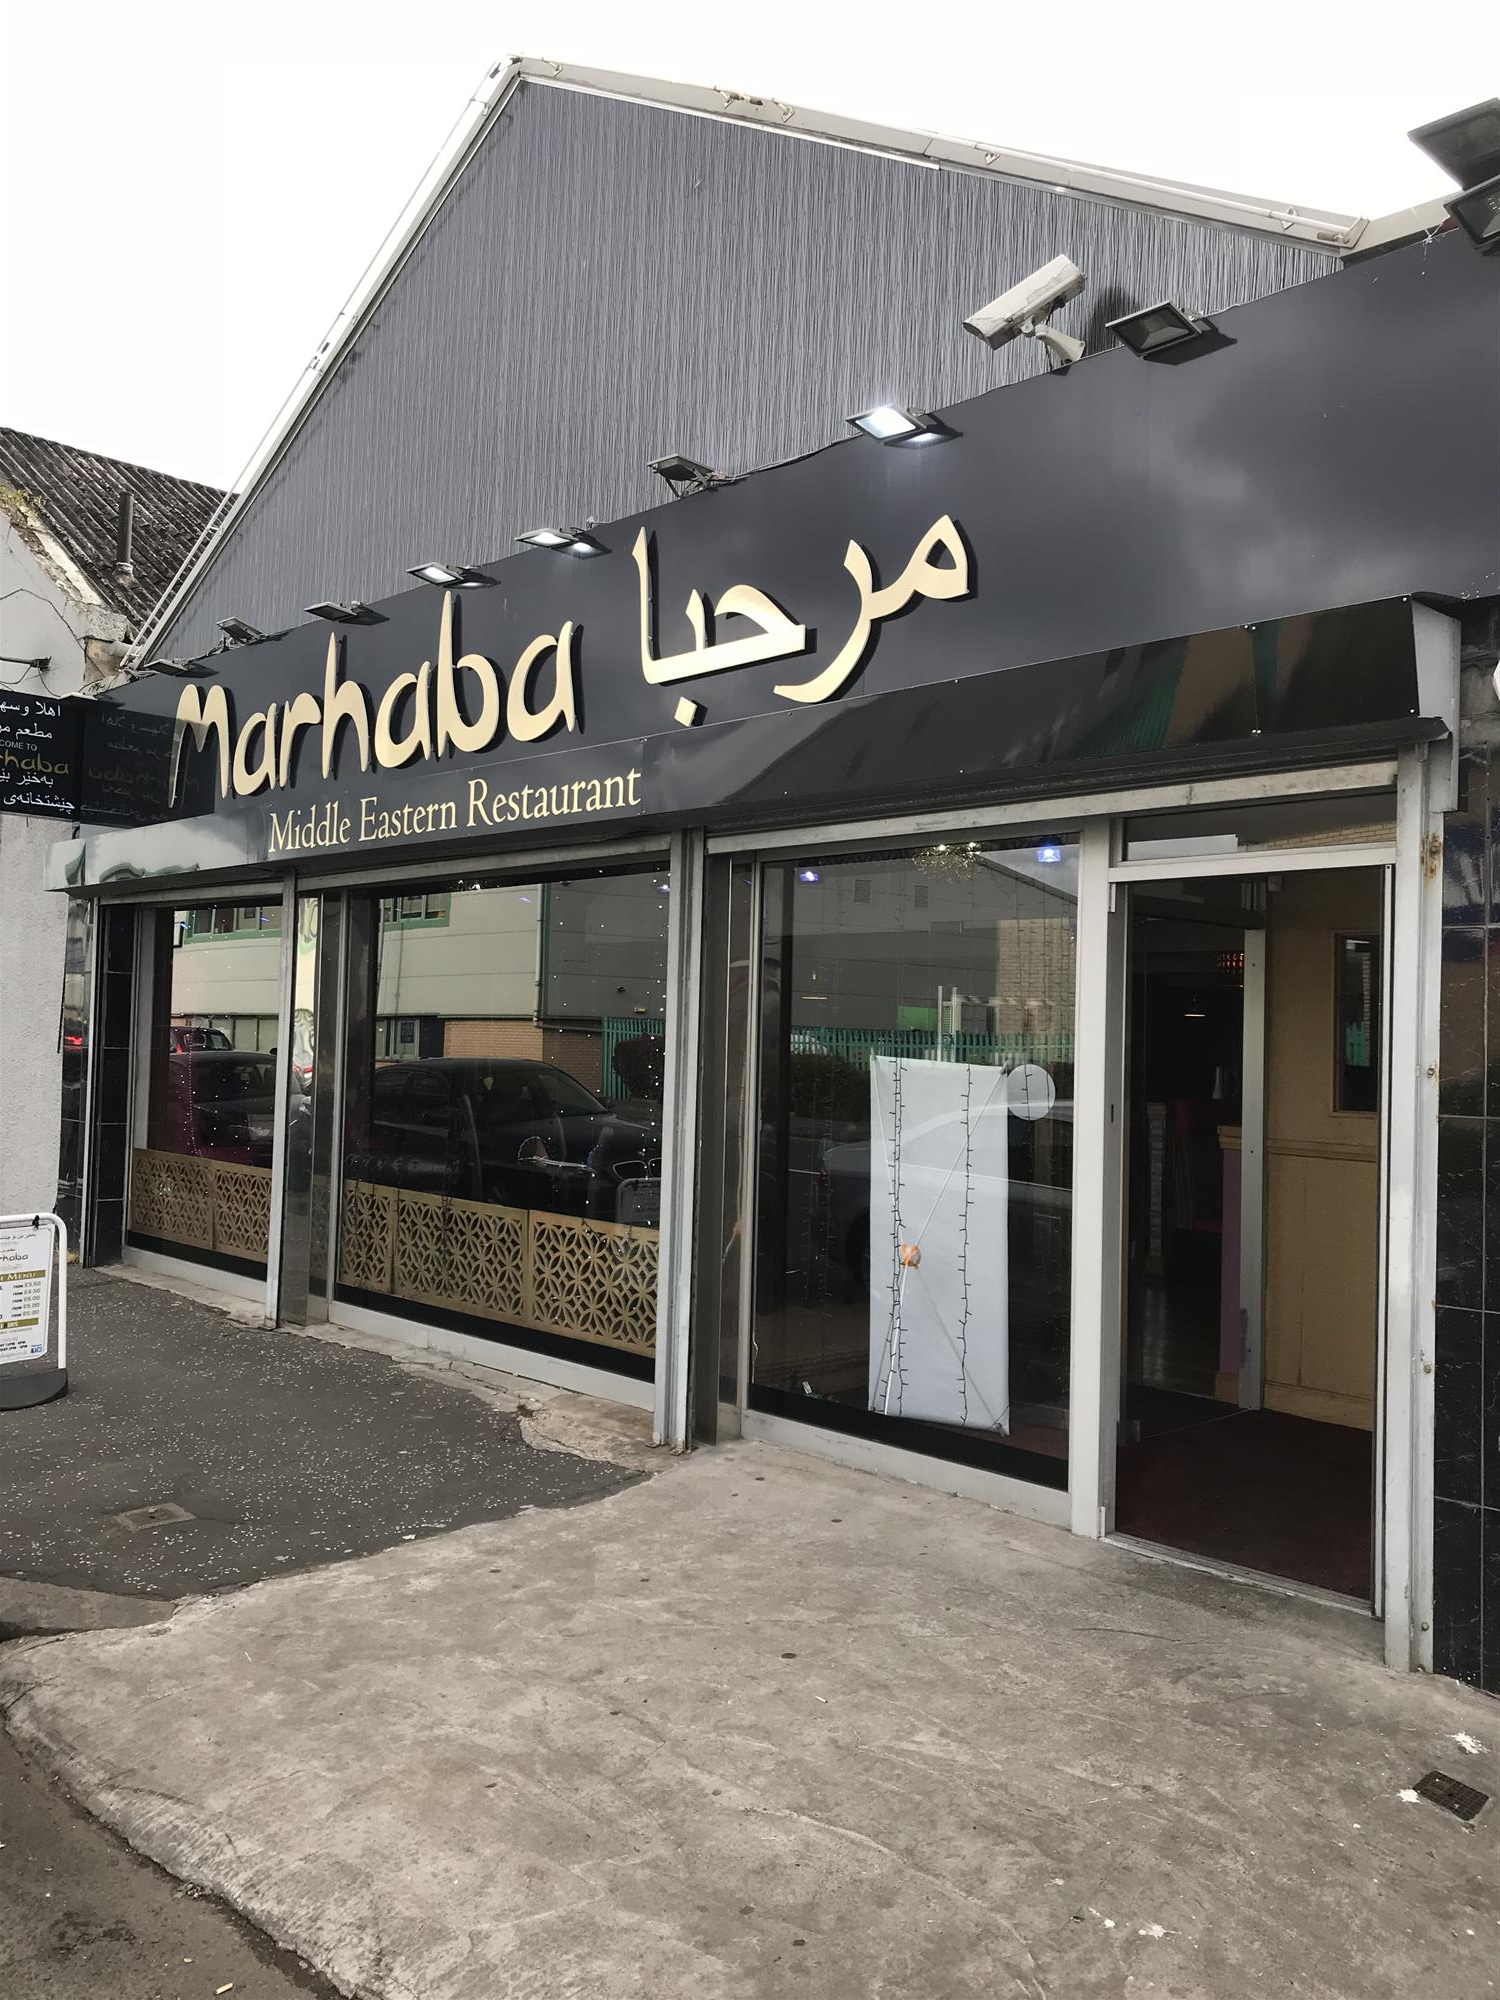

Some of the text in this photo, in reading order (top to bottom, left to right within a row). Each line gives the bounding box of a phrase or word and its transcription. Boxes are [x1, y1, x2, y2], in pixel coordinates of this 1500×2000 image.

[632, 514, 969, 728] مرحبا
[25, 743, 38, 751] TO
[169, 591, 578, 808] Marhaba
[268, 768, 643, 853] Middle Eastern Restaurant
